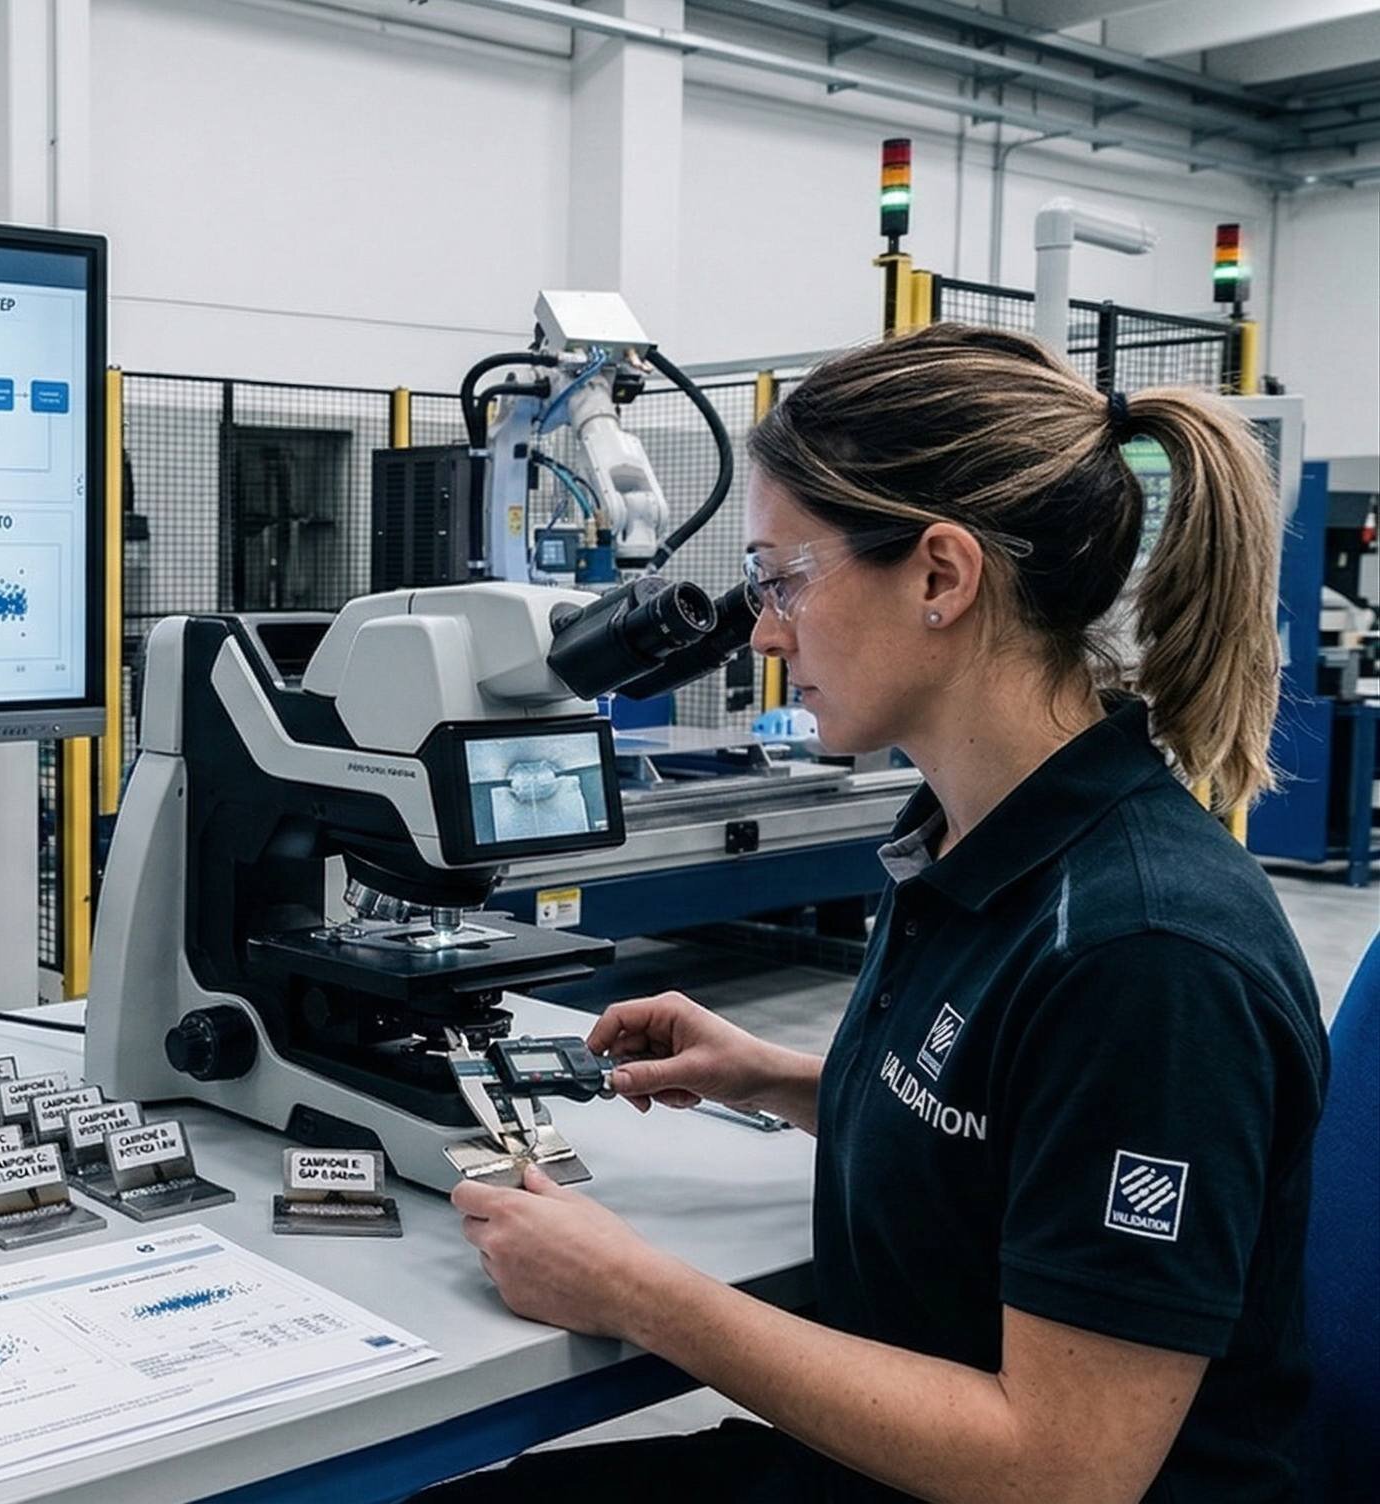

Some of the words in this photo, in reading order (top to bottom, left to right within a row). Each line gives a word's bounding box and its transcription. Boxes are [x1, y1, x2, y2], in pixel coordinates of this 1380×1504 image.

[879, 1050, 987, 1141] VALIDATION
[299, 1157, 348, 1169] CAMPIONE
[299, 1169, 319, 1180] GAP
[1112, 1209, 1171, 1234] VALIDATION
